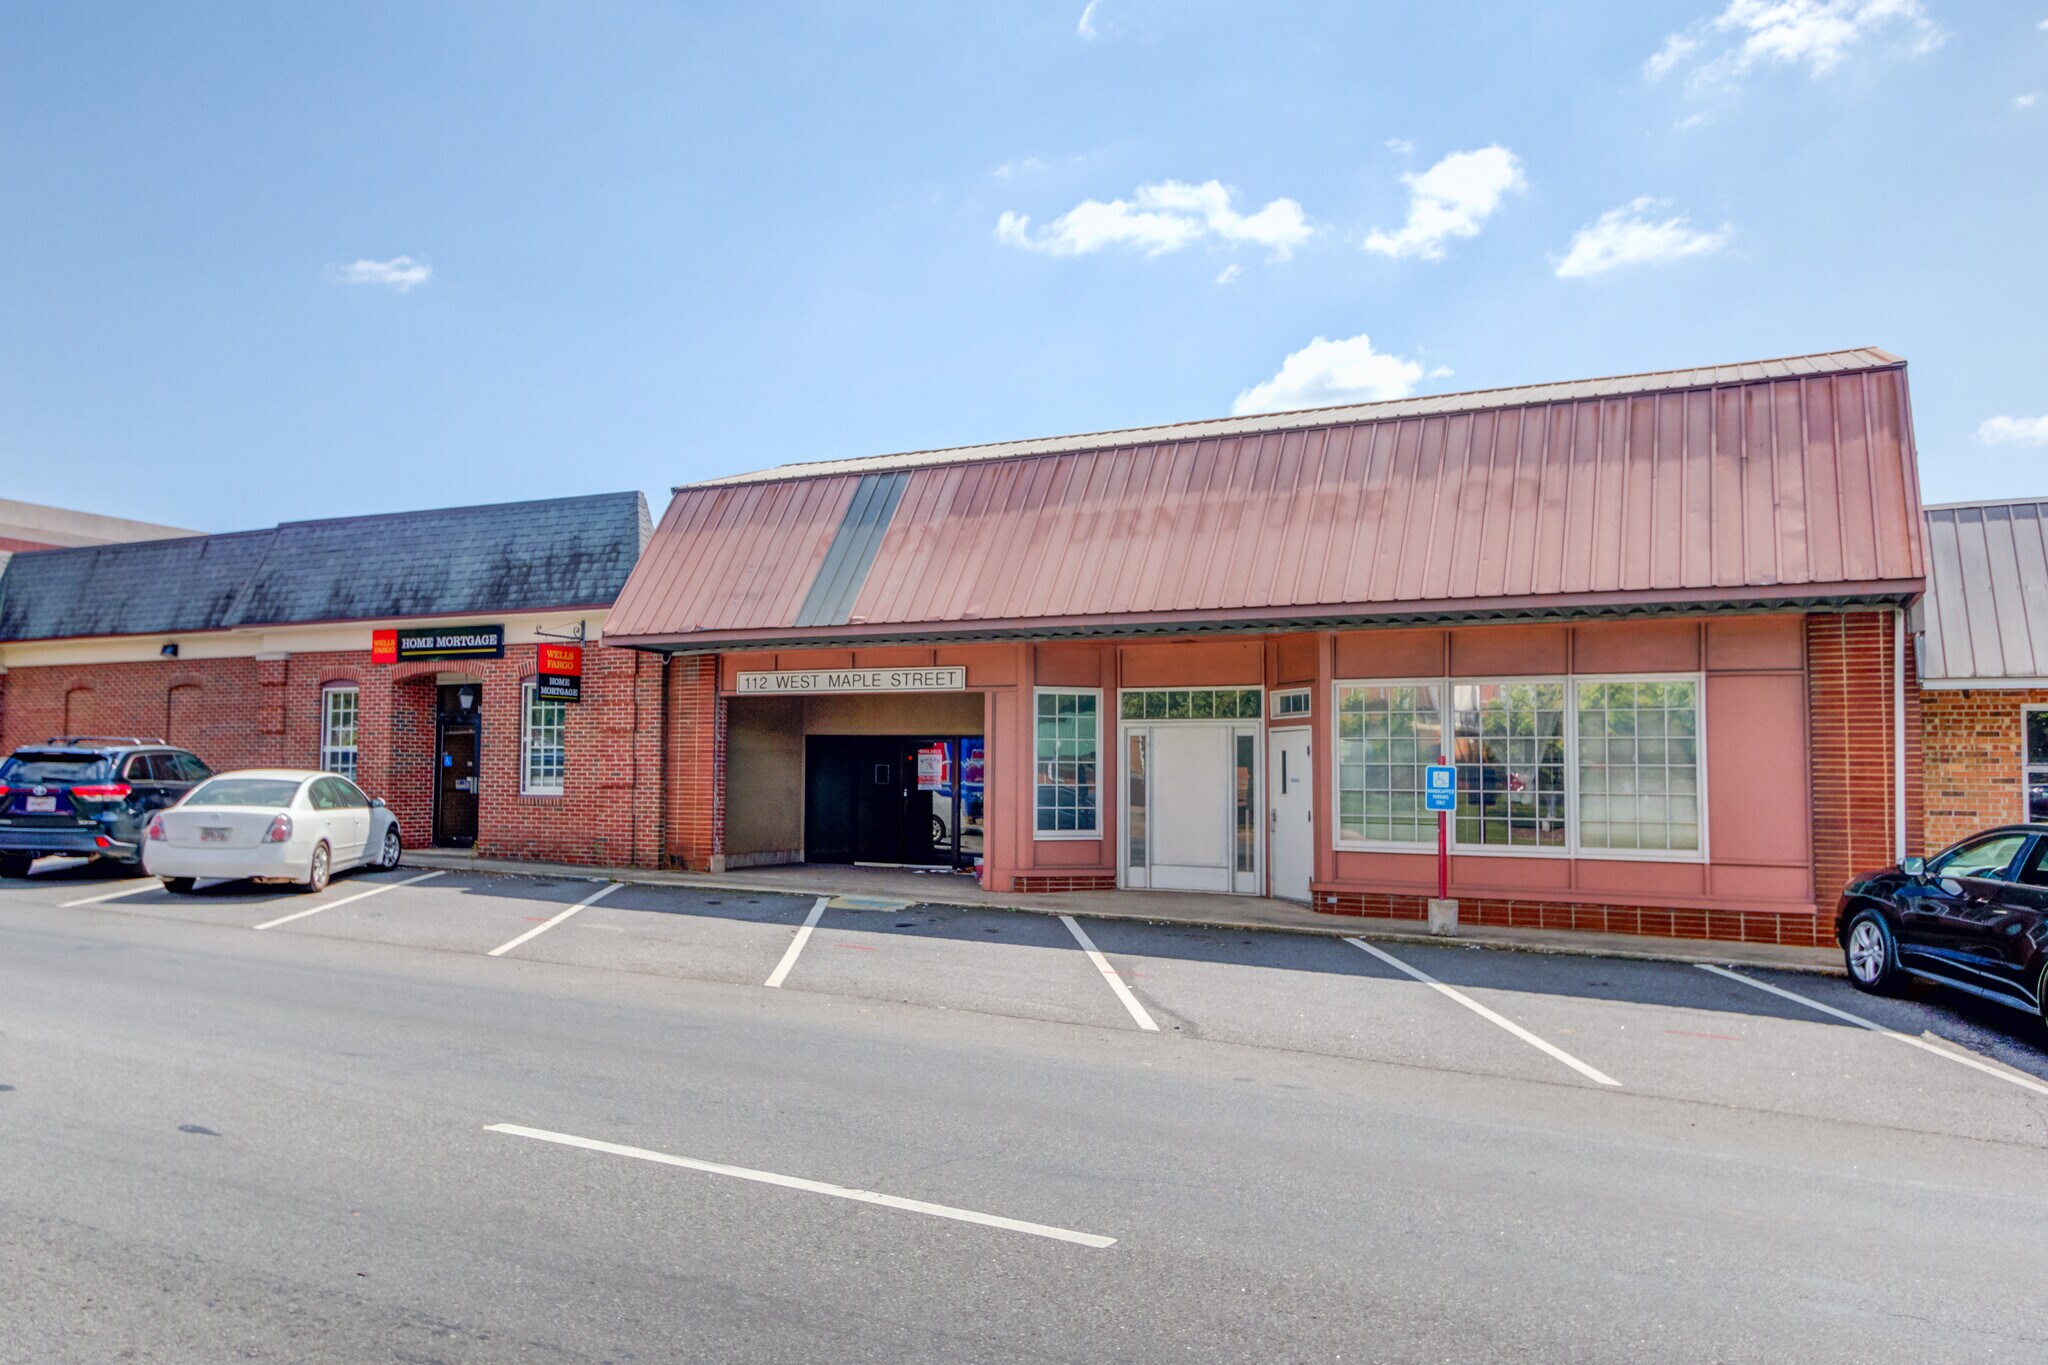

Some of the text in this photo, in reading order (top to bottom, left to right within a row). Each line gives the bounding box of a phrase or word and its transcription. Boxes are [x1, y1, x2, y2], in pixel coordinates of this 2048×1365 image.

[374, 639, 396, 647] WELLS
[402, 634, 497, 649] HOME MORTGAGE
[374, 646, 395, 654] FARGO
[546, 649, 574, 661] WELLS
[546, 659, 574, 670] FARGO
[549, 677, 571, 687] HOME
[745, 671, 957, 690] 112 WEST MAPLE STREET
[540, 686, 578, 697] MORTGAGE
